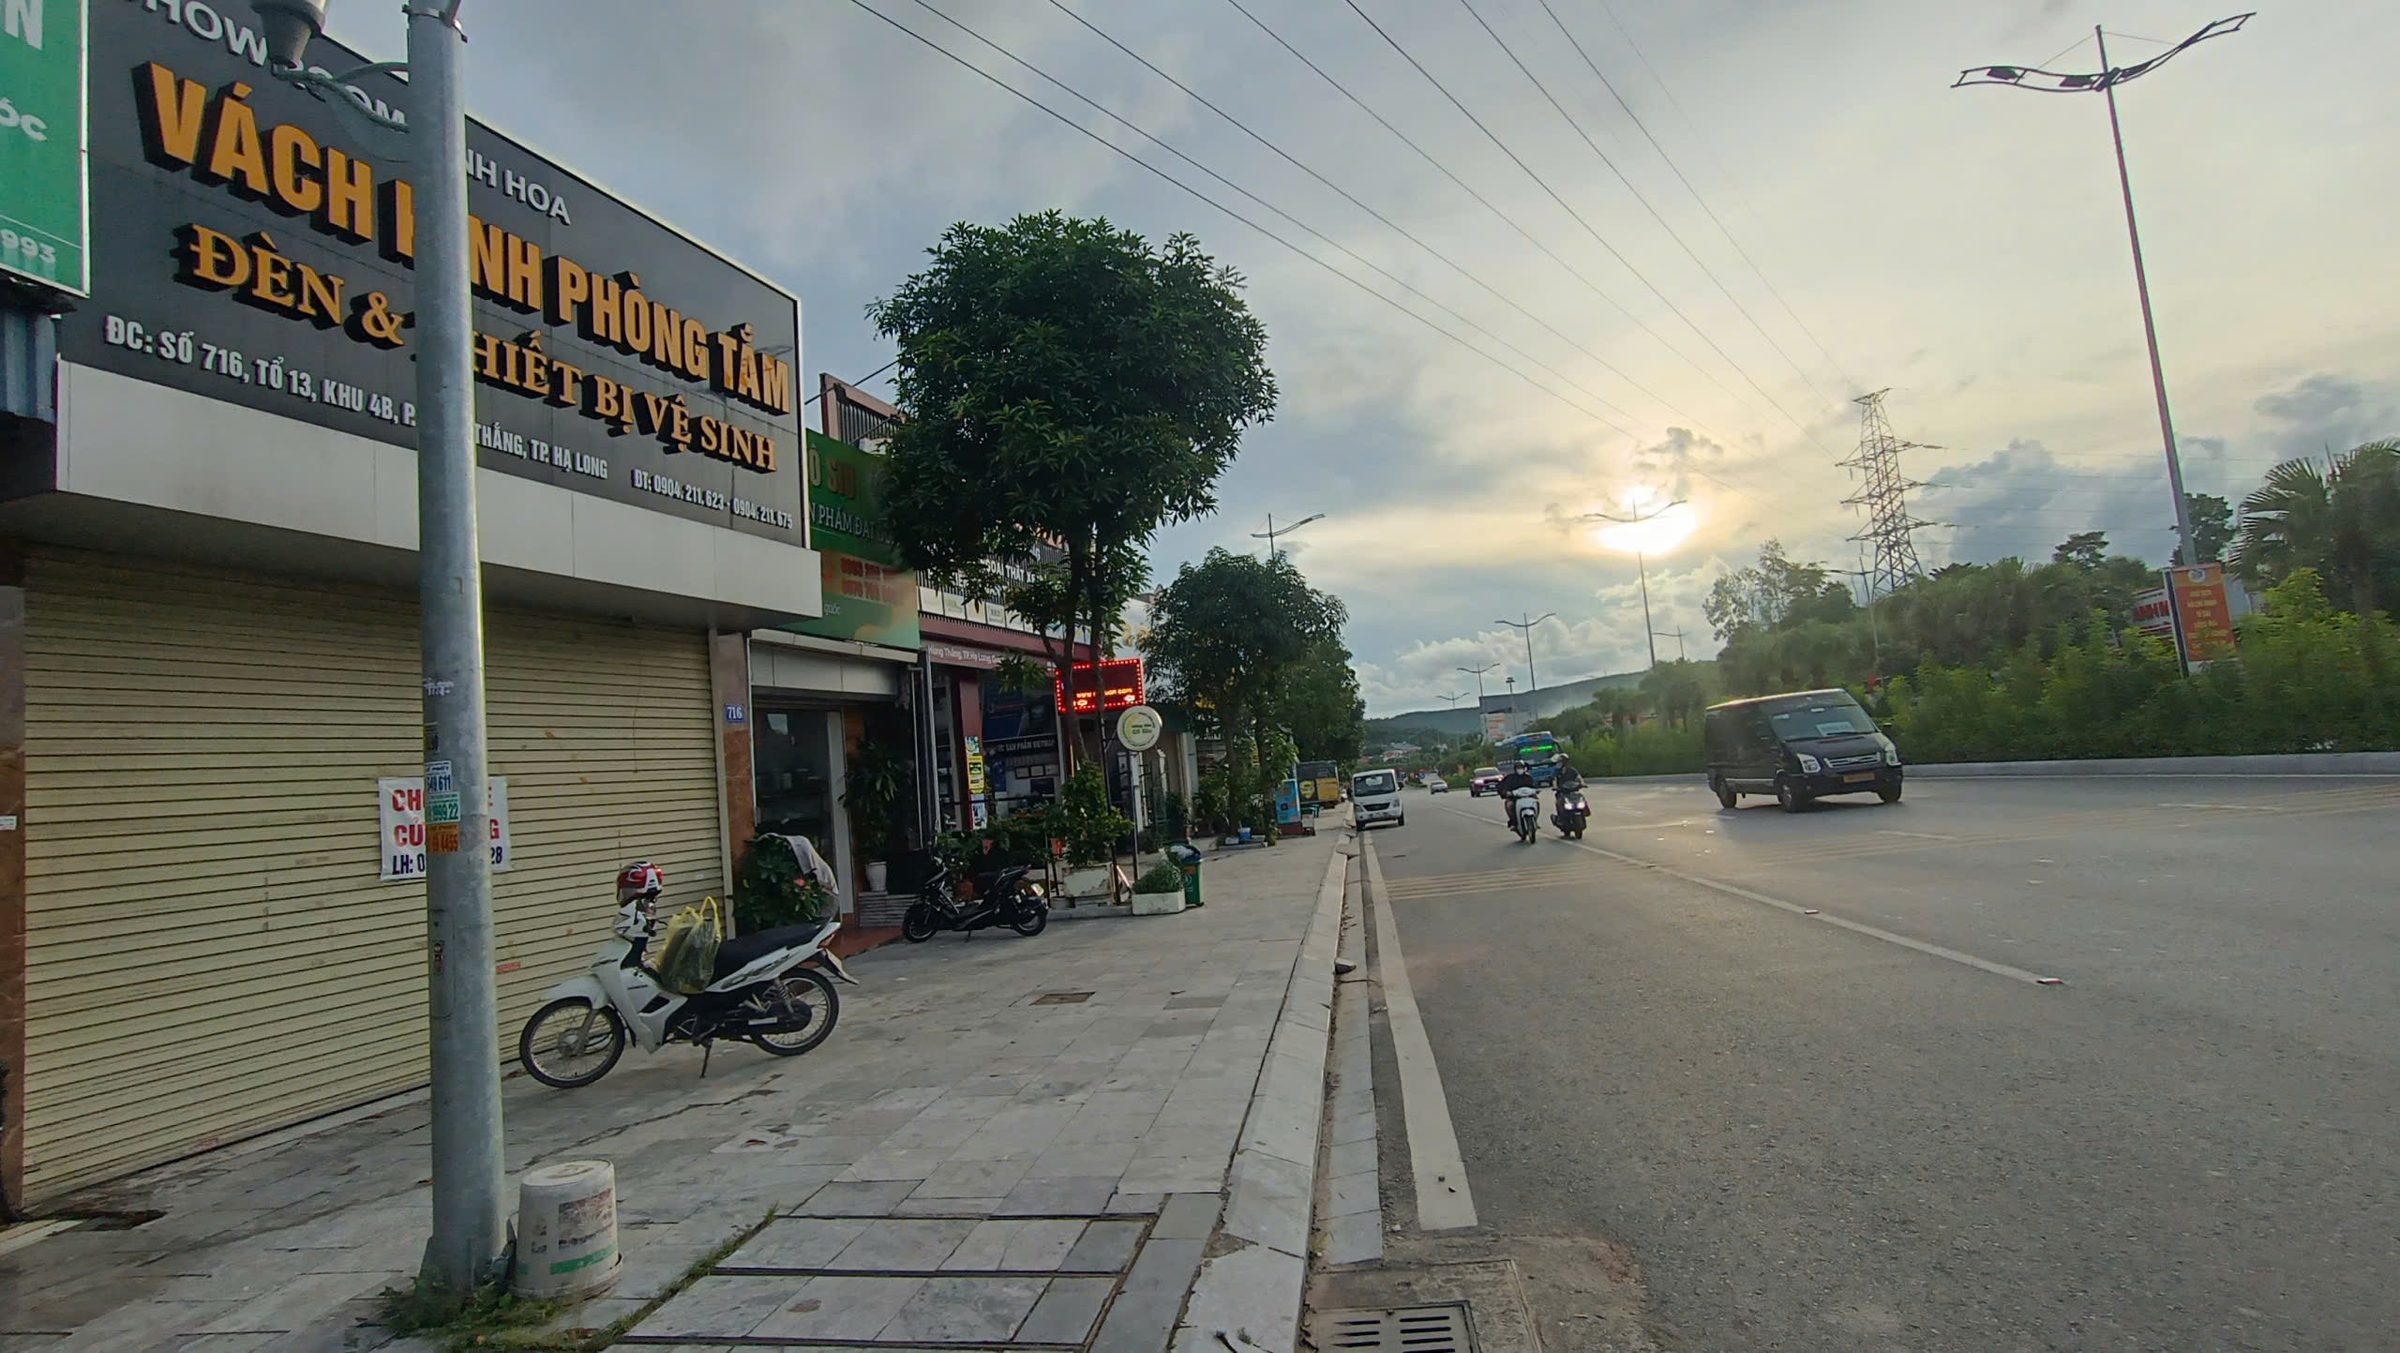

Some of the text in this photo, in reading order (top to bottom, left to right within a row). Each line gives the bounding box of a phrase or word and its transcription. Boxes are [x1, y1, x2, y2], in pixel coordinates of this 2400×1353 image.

[504, 169, 571, 225] HOA
[150, 61, 373, 241] VÁCH
[557, 255, 708, 381] PHÒNG
[717, 322, 791, 415] TẮM
[190, 224, 777, 471] ĐÈN & HIẾT BỊ VỆ SINH
[104, 314, 152, 354] ĐC:
[158, 330, 194, 364] SỐ
[201, 342, 250, 384] 716,
[255, 356, 286, 390] TỔ
[289, 369, 317, 402] 13,
[322, 379, 364, 412] KHU
[553, 446, 573, 473] HẠ
[575, 451, 608, 479] LONG
[726, 705, 743, 720] 716
[391, 788, 426, 812] CH
[391, 854, 414, 876] LH:
